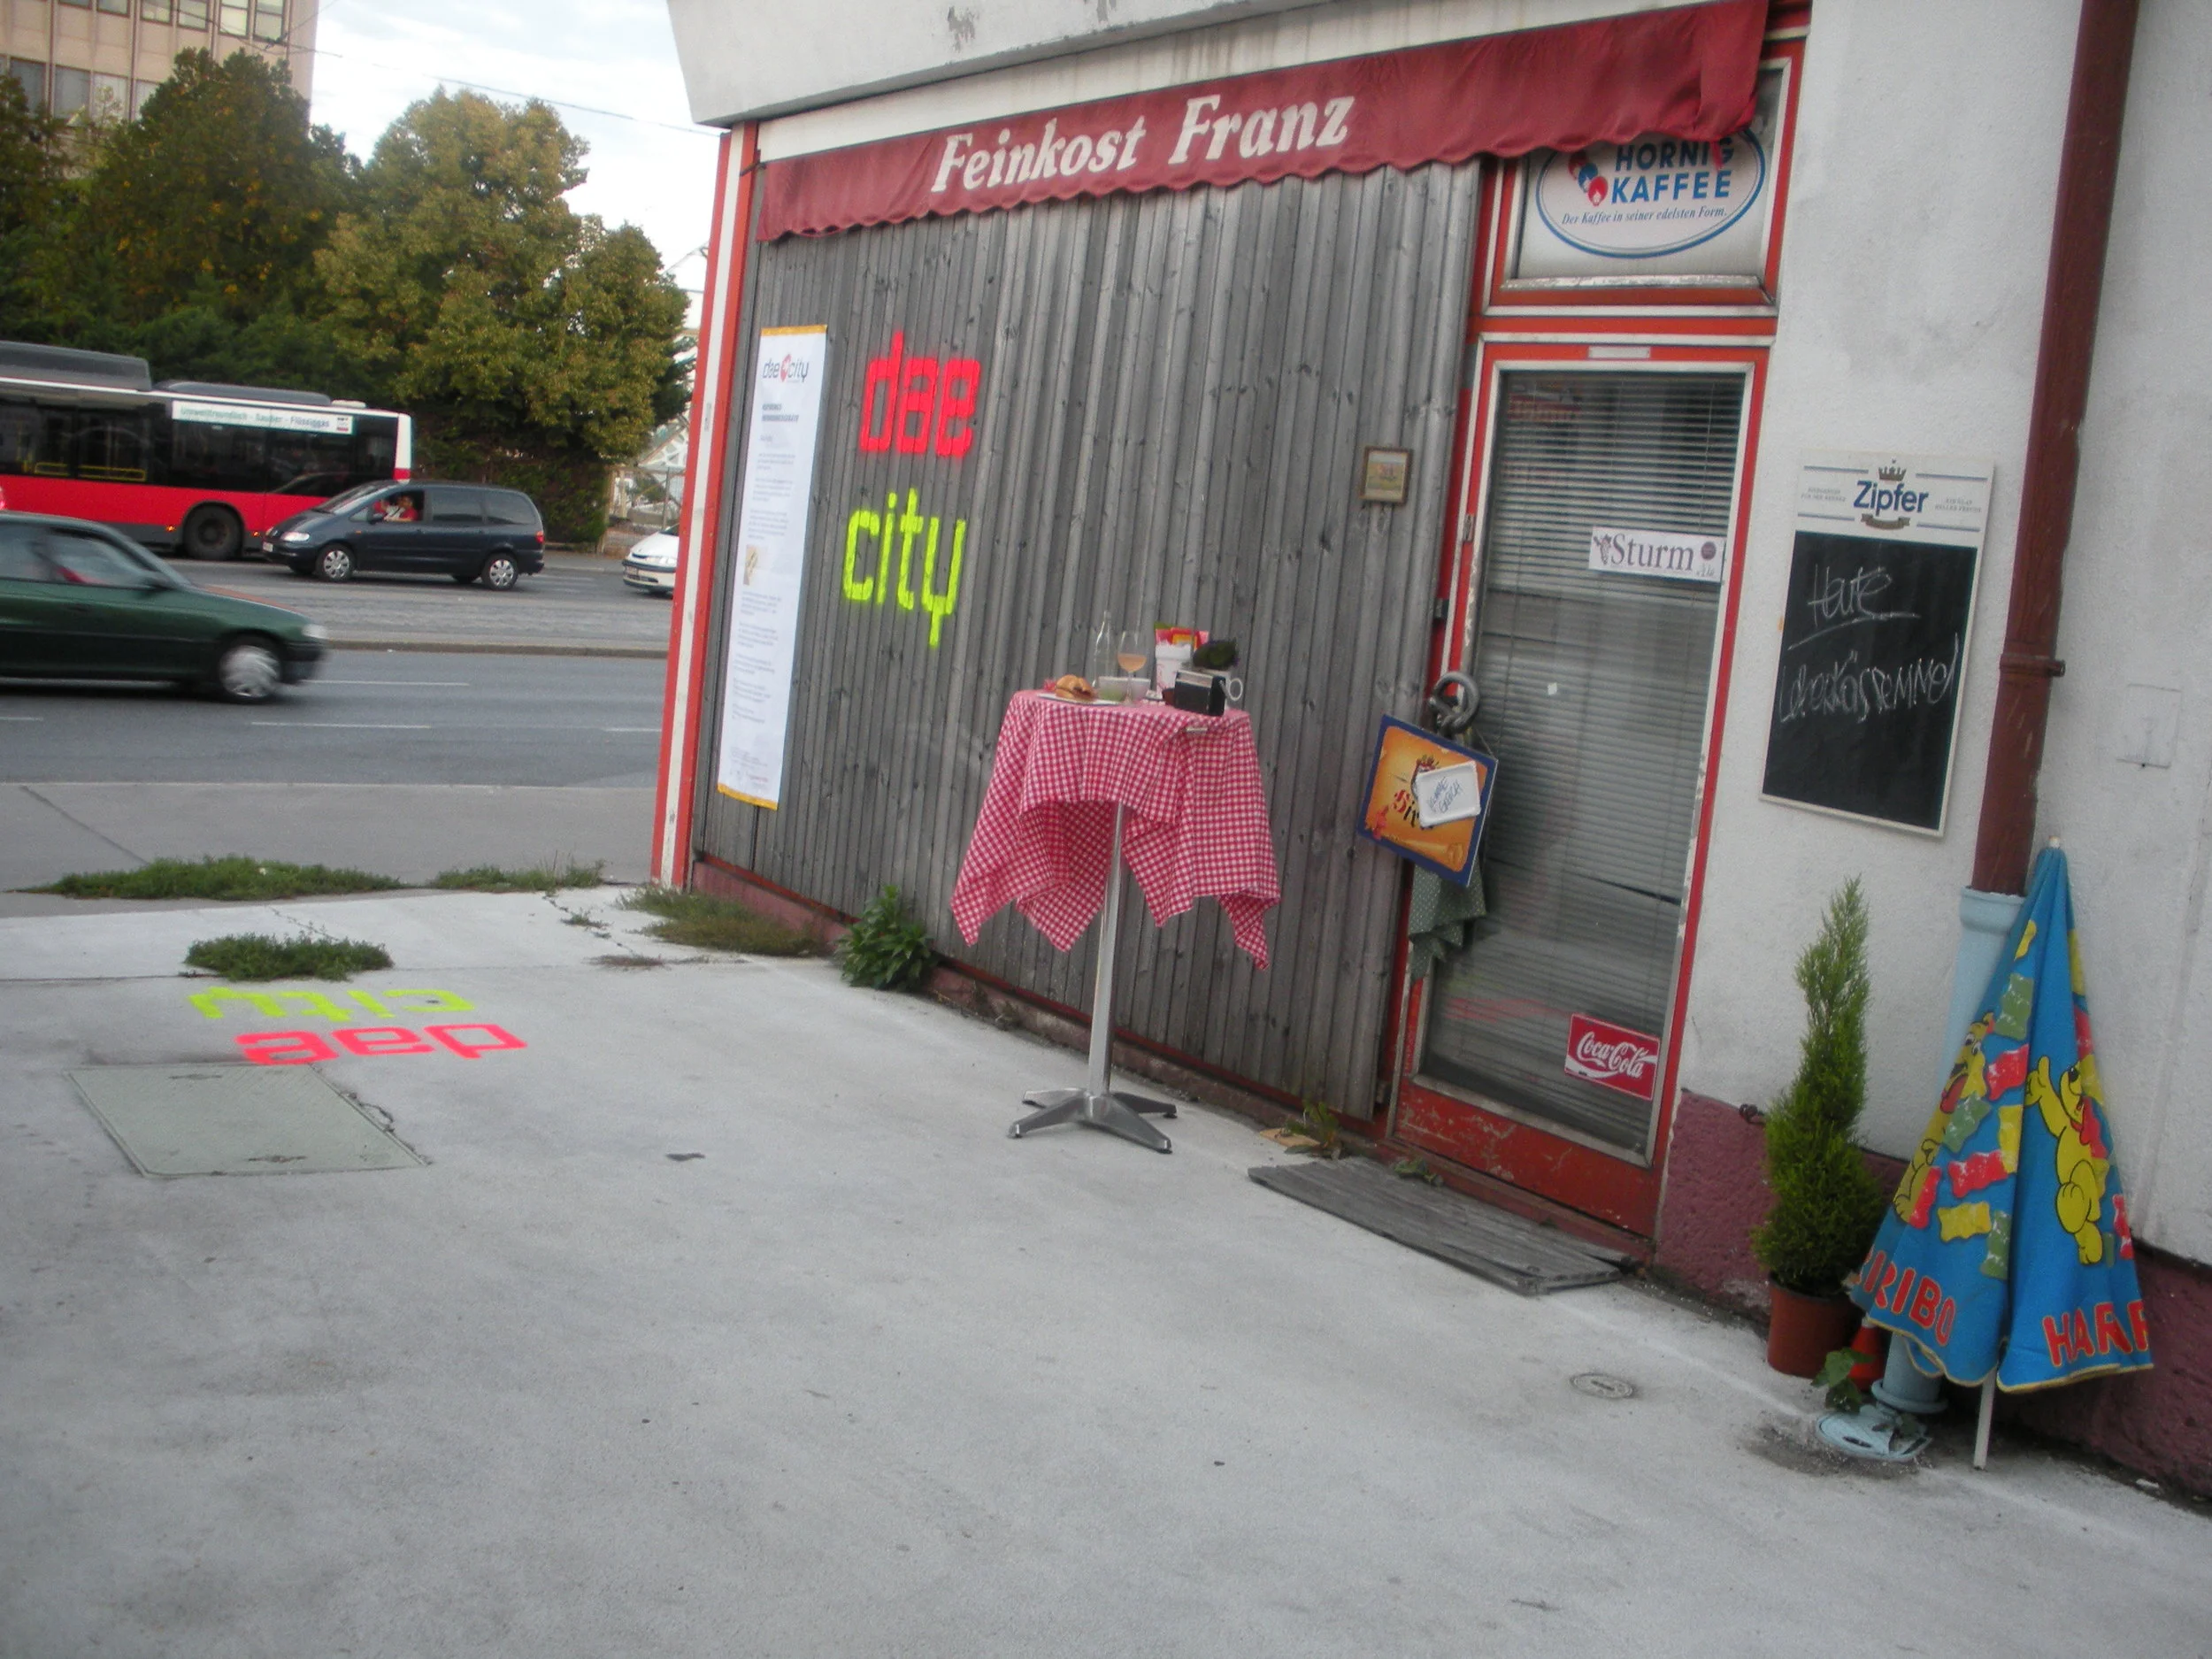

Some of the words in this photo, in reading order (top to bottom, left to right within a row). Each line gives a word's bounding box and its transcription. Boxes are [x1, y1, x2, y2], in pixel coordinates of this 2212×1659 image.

[930, 117, 1148, 194] Feinkost
[1168, 93, 1356, 166] Franz
[1611, 169, 1733, 205] KAFFEE
[1562, 212, 1579, 225] Der
[1581, 211, 1611, 226] Kaffee
[1613, 210, 1623, 222] in
[1625, 208, 1655, 221] seiner
[1657, 206, 1696, 220] edelsten
[1699, 204, 1728, 218] Form.
[858, 331, 982, 460] dae
[1853, 480, 1930, 517] Zipfer
[842, 488, 967, 649] city
[1610, 533, 1694, 572] Sturm
[1577, 1031, 1649, 1079] Coca-Cola
